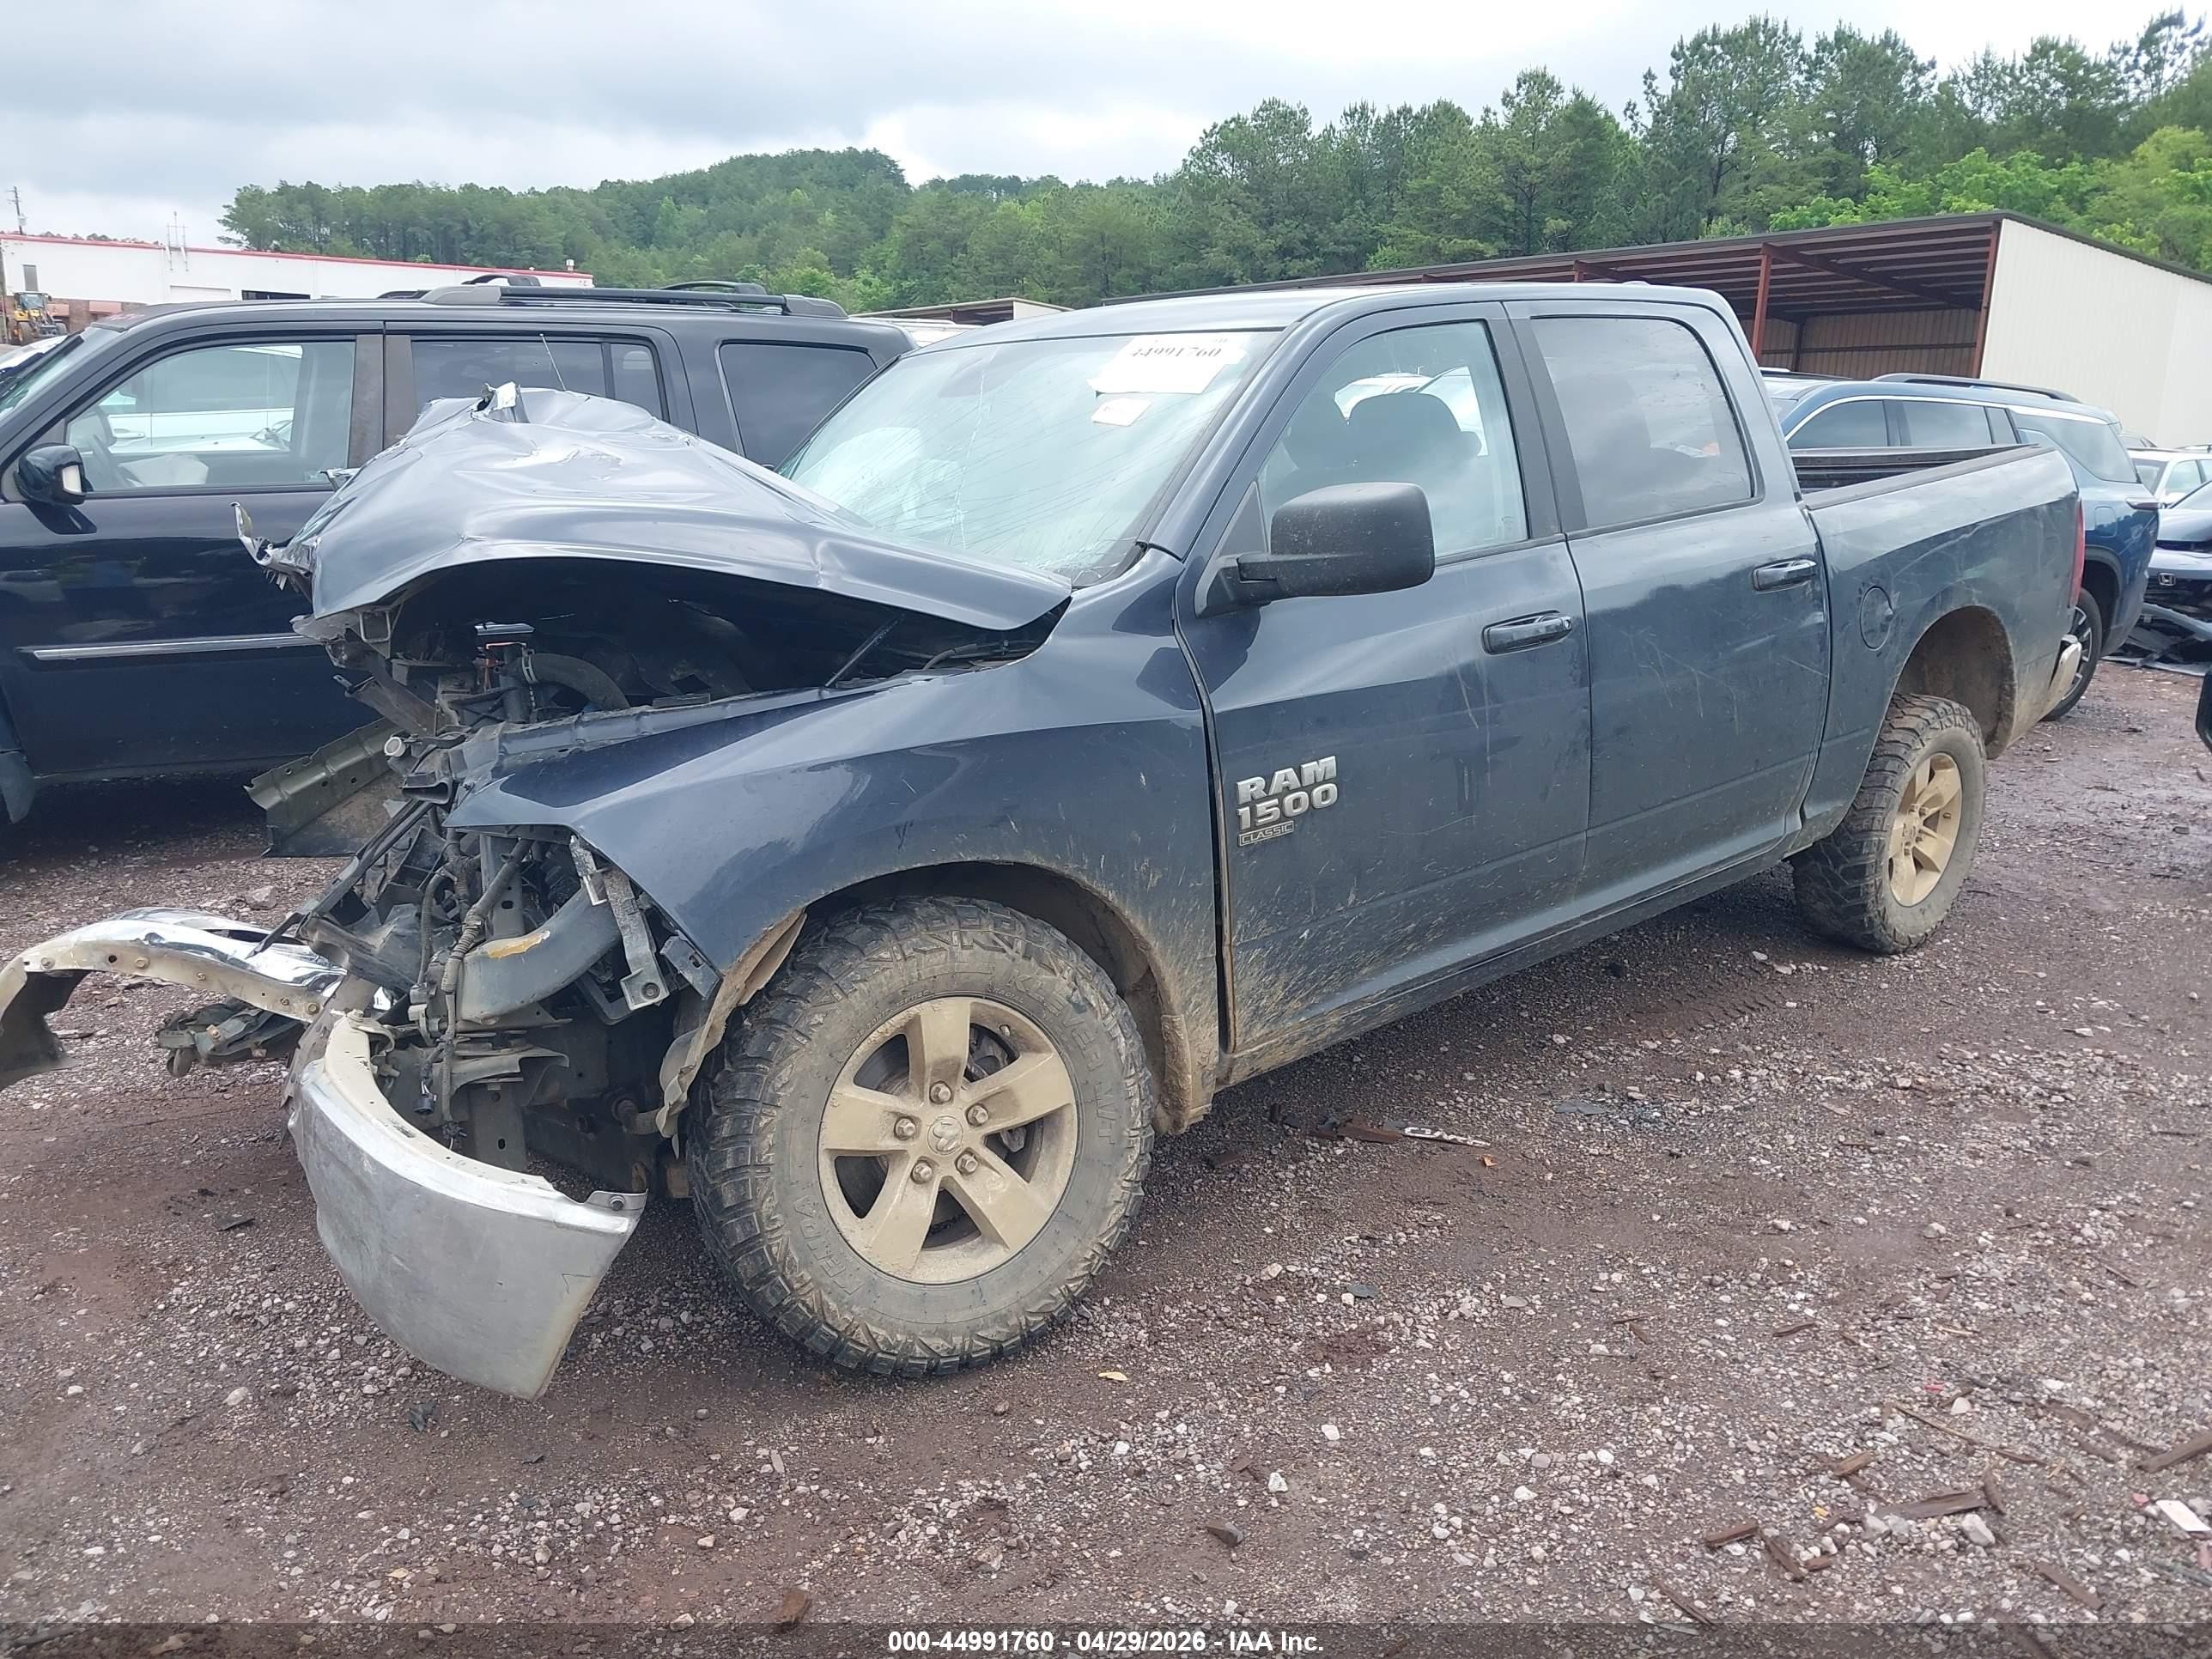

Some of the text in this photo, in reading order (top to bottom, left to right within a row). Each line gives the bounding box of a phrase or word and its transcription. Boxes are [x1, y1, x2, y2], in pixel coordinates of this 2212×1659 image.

[1236, 755, 1337, 805] RAM
[1237, 782, 1338, 830] 1500
[1240, 821, 1294, 845] CLASSIC
